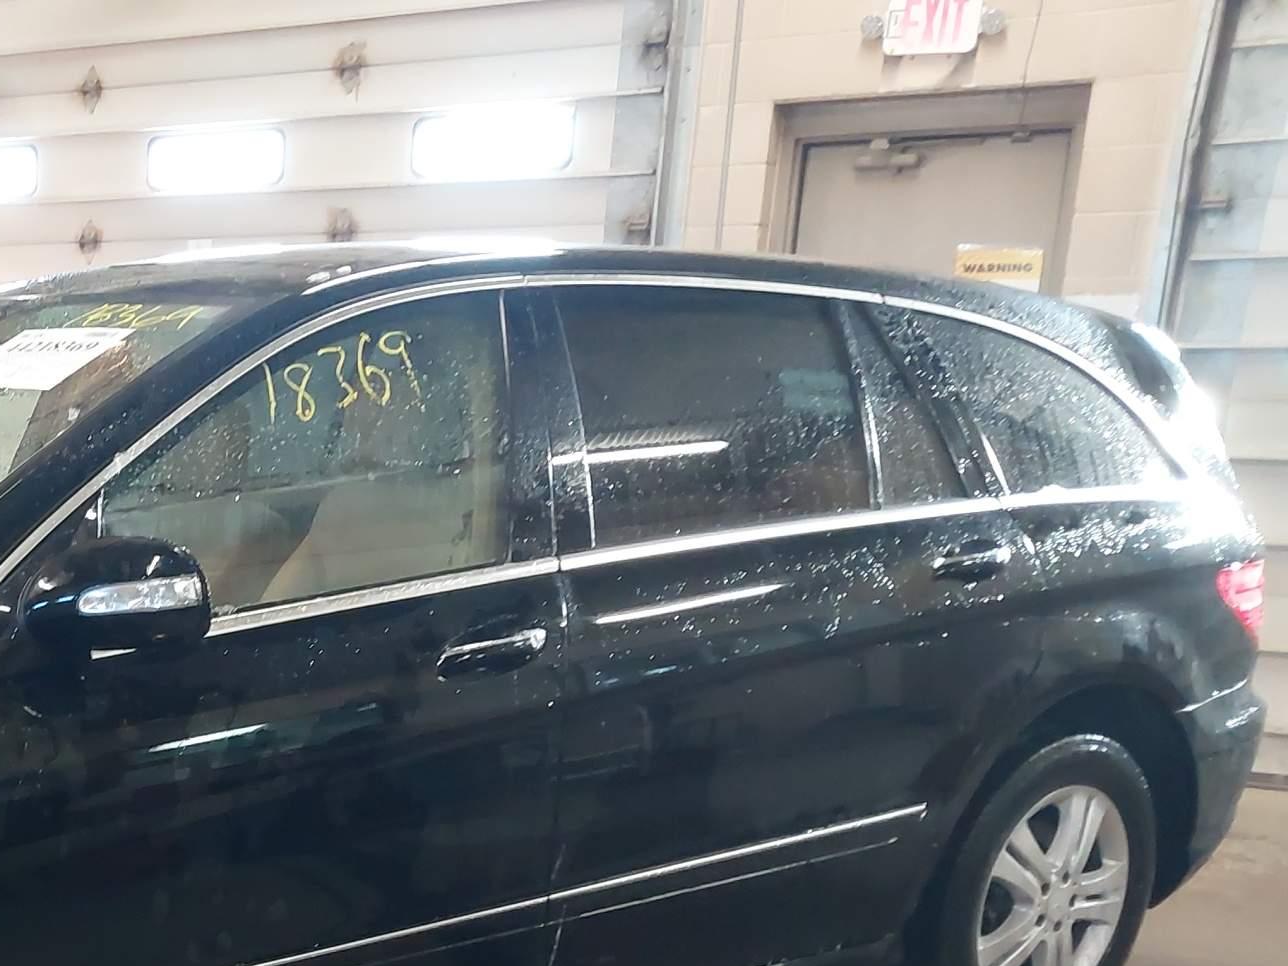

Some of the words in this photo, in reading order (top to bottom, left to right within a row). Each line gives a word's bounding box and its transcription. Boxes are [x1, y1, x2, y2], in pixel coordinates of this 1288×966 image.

[901, 0, 971, 47] EXIT
[963, 262, 1034, 274] WARNING
[262, 330, 422, 425] 18369
